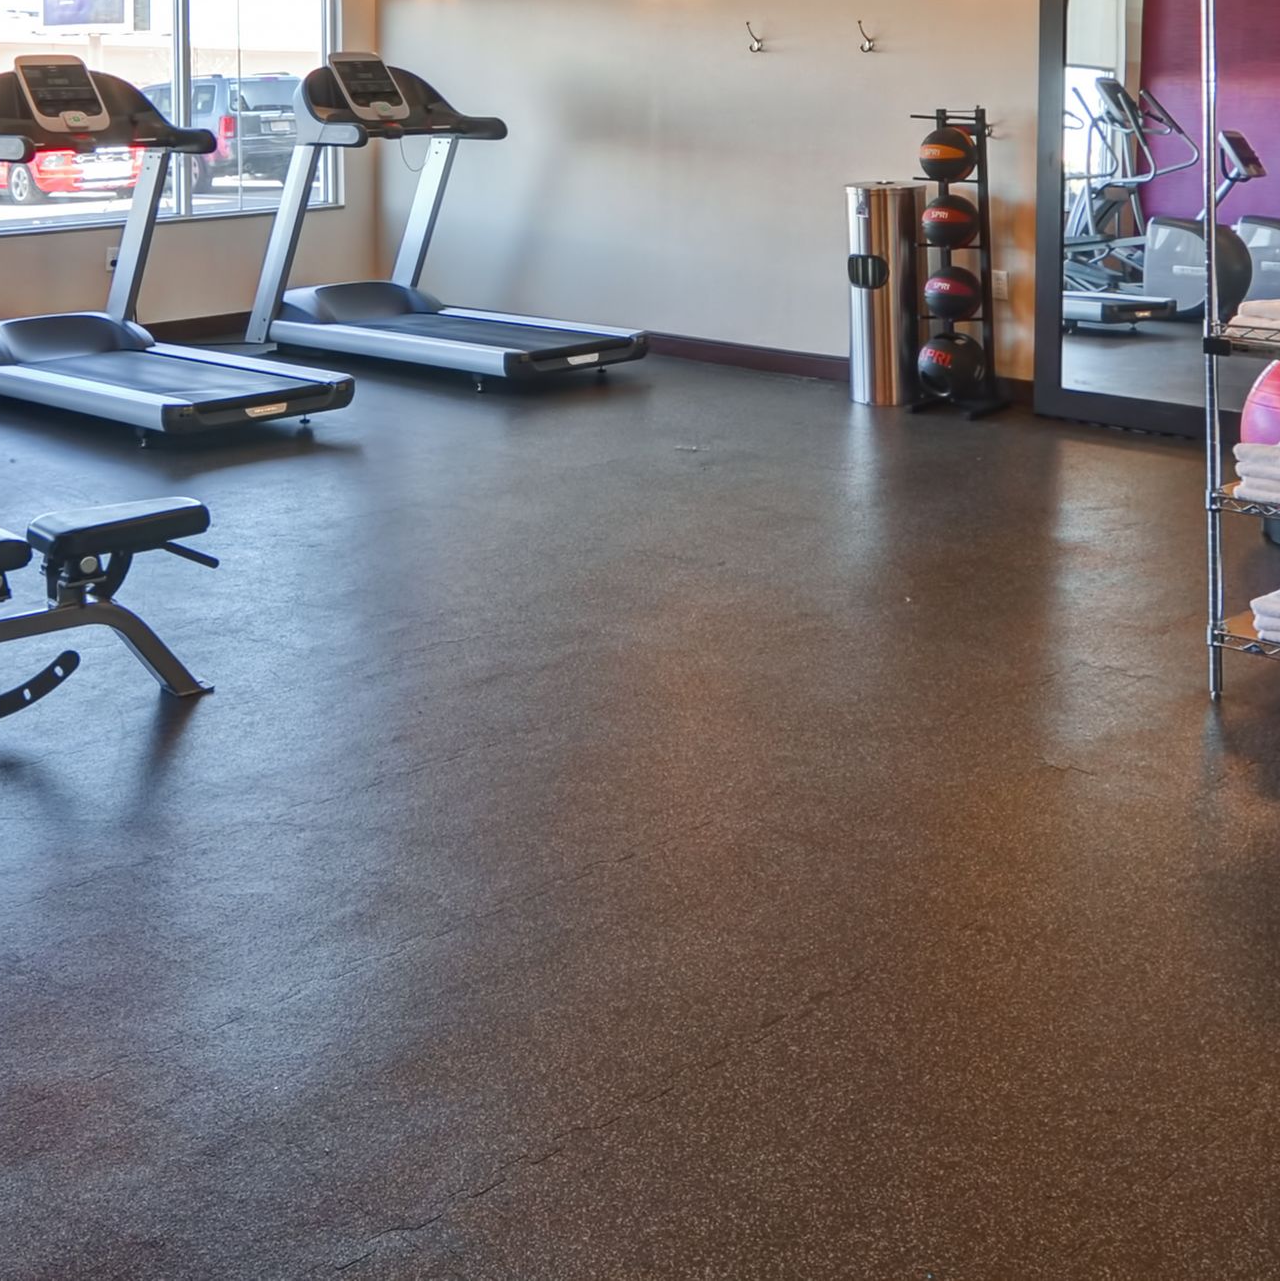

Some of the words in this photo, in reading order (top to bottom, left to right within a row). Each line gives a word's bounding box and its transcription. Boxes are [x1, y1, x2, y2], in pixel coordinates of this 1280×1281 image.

[924, 148, 940, 156] SPRI
[931, 211, 948, 219] SPRI
[933, 282, 950, 290] SPRI
